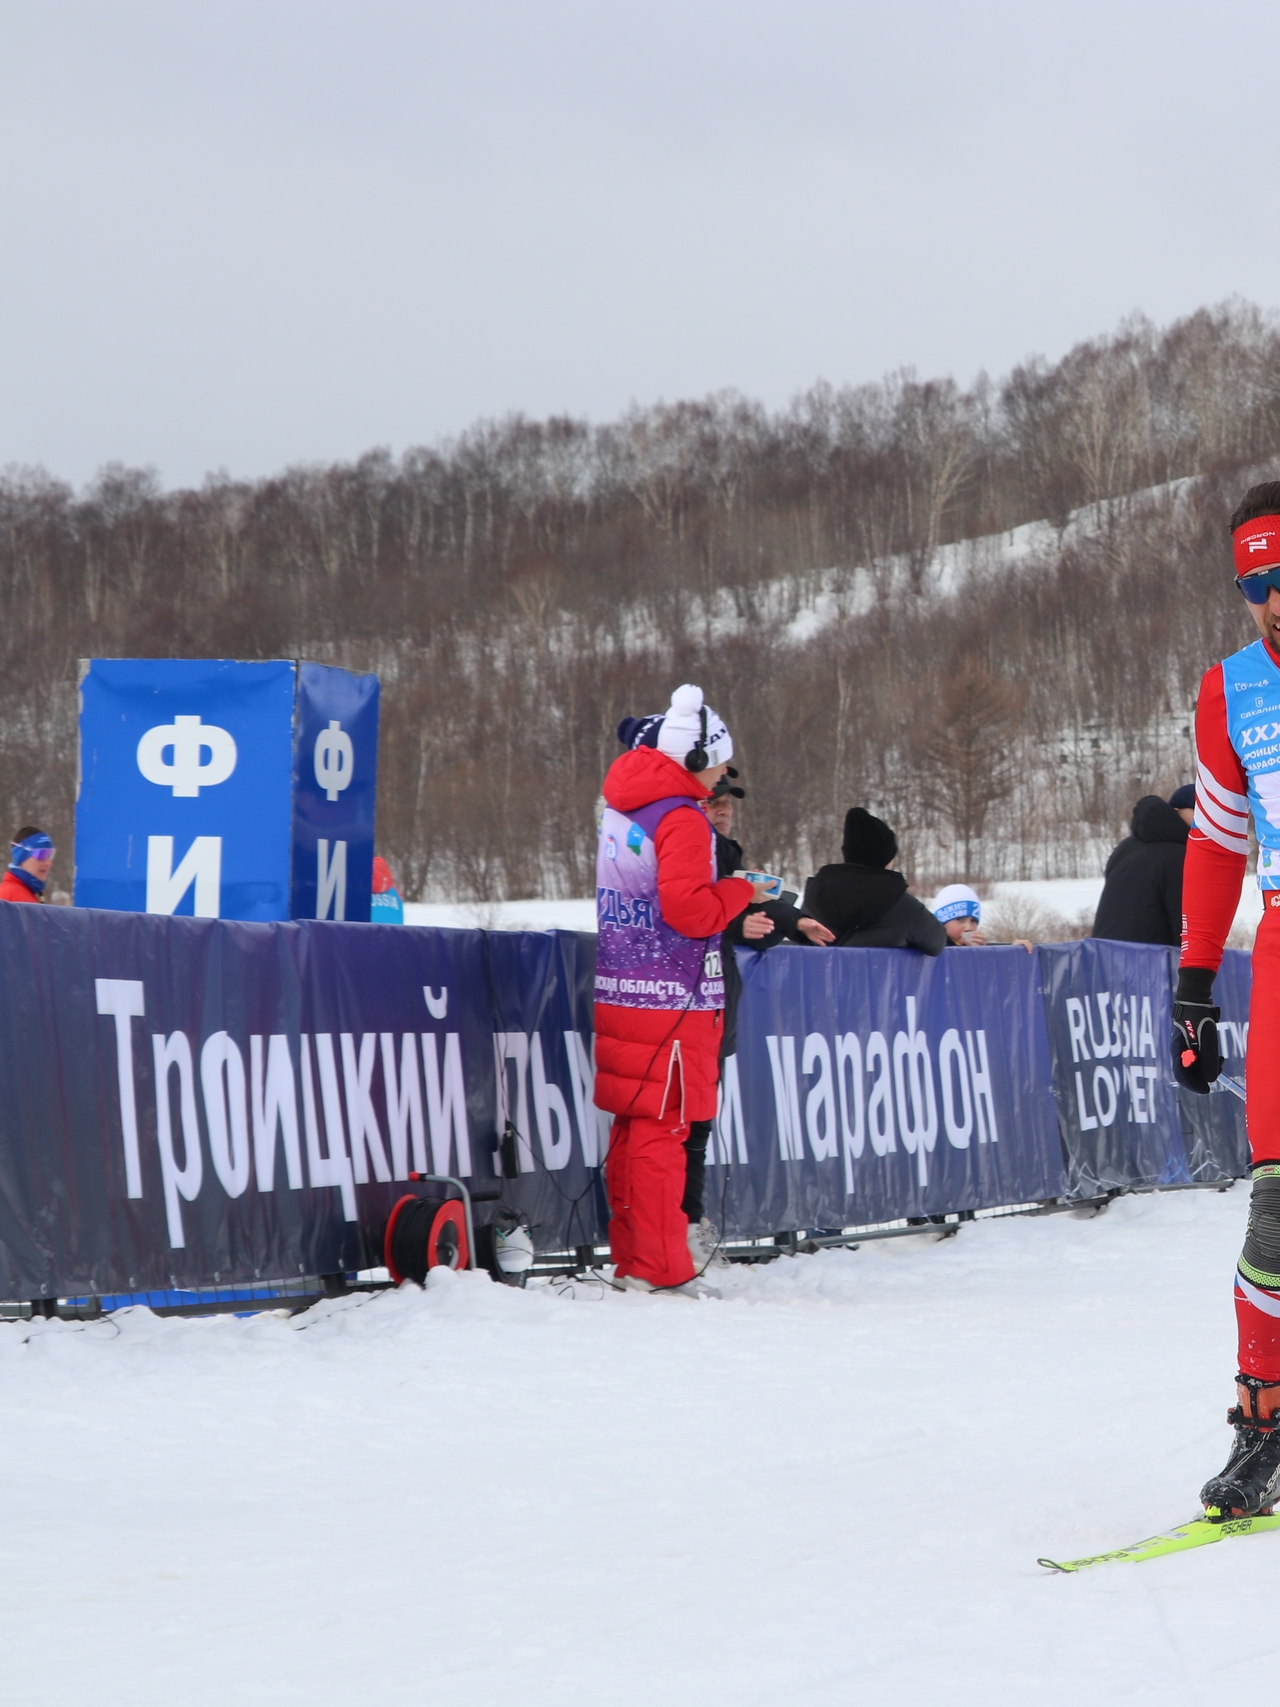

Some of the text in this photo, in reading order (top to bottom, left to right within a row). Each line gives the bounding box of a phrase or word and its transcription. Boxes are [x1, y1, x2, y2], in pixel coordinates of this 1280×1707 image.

[95, 978, 471, 1249] Троицкий
[766, 996, 998, 1194] марафон
[1075, 1065, 1157, 1131] LOET
[1219, 1519, 1253, 1536] FISCHER
